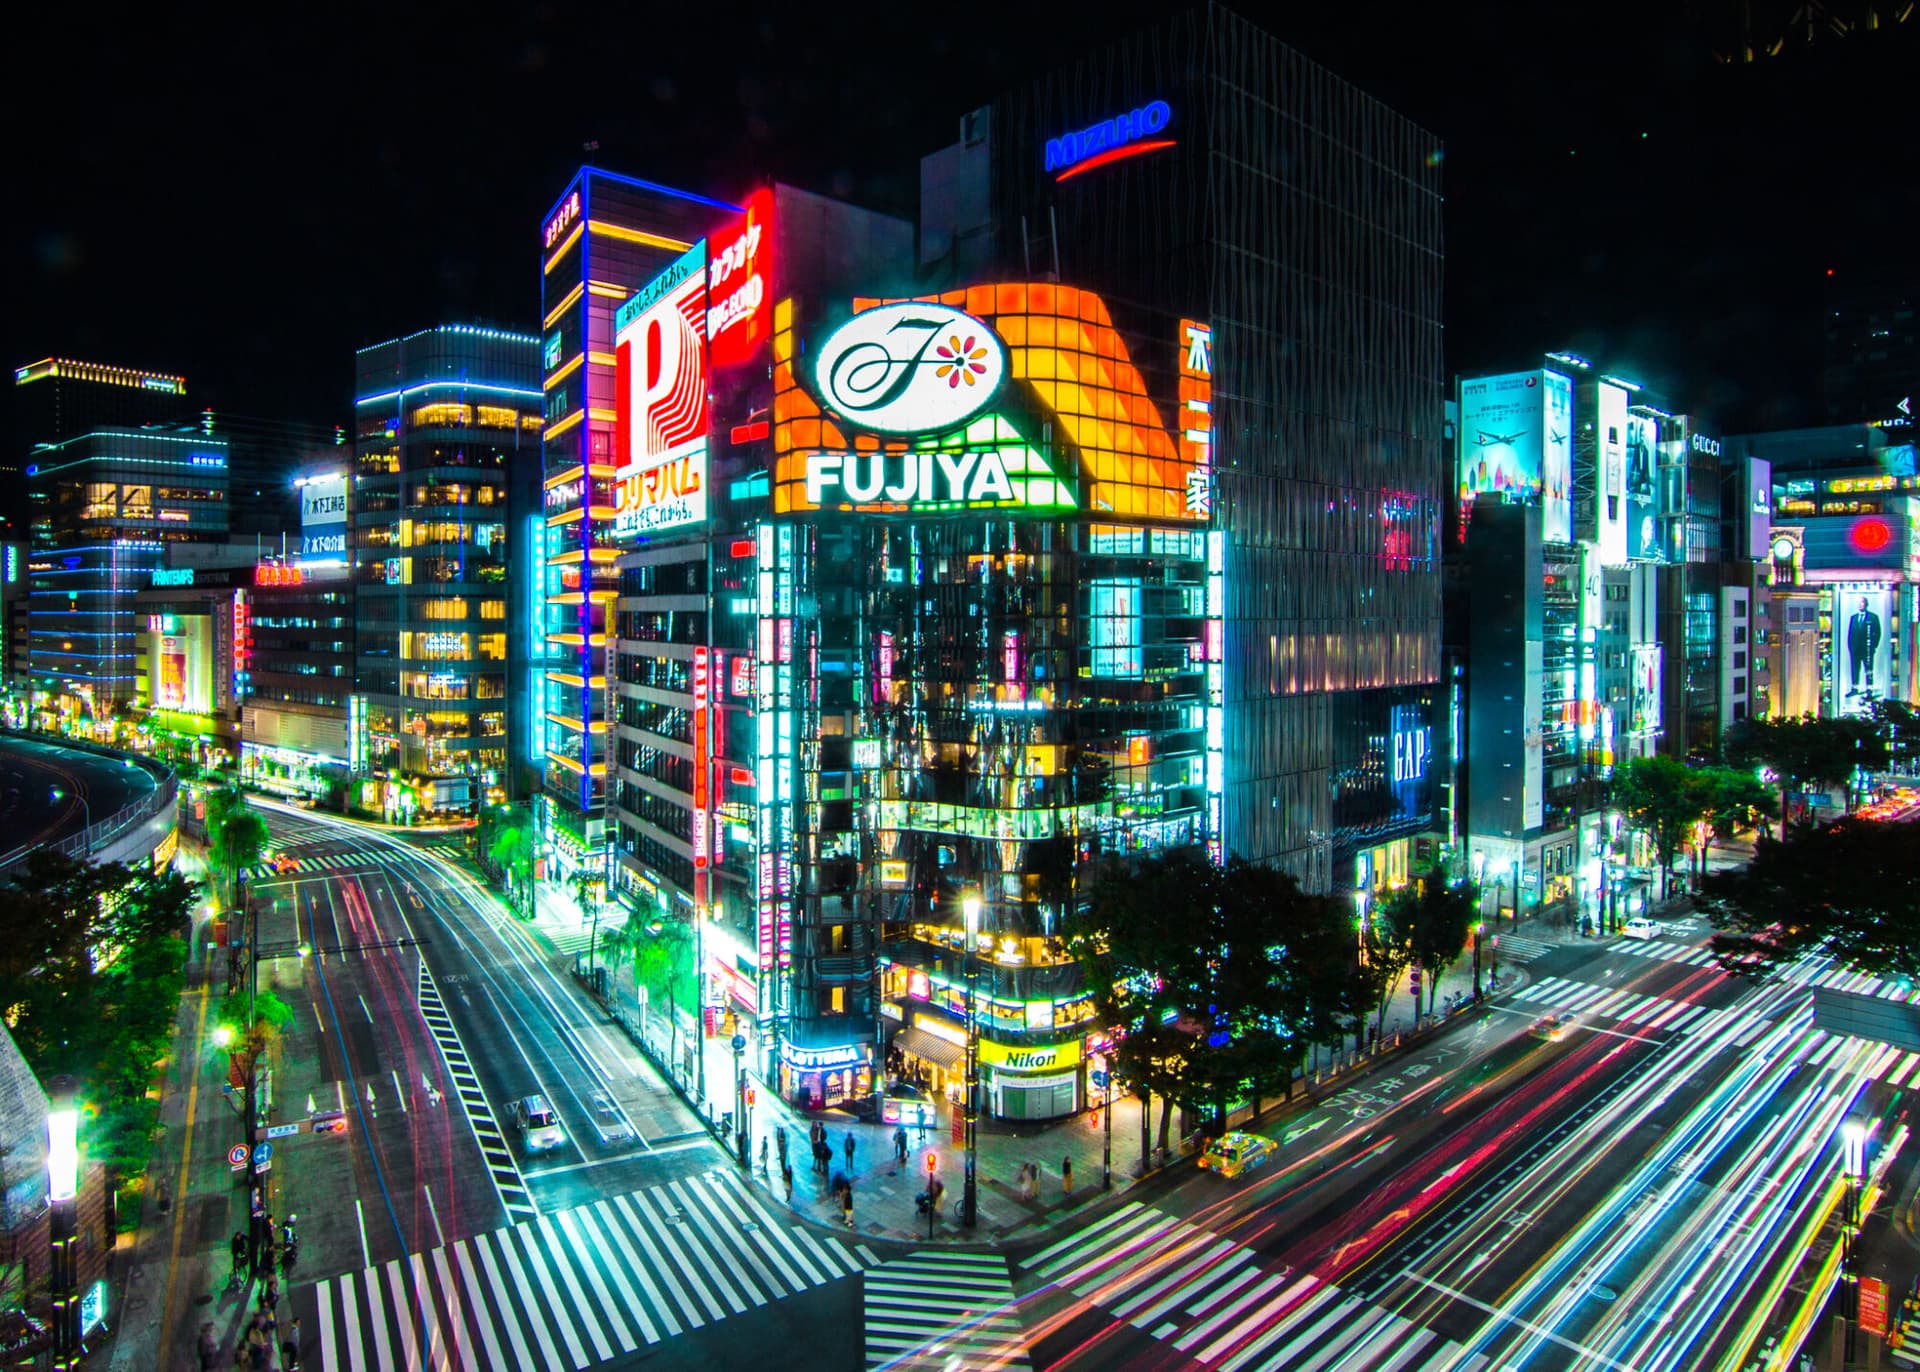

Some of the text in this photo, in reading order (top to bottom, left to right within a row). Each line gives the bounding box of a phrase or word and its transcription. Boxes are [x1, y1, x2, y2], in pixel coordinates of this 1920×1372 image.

[1045, 100, 1170, 171] MIZUHO
[709, 224, 762, 291] カラオケ
[729, 273, 764, 318] ECHO
[1186, 326, 1211, 516] 不二家
[1692, 433, 1720, 456] GUCCI
[614, 456, 701, 514] プリマハム
[807, 452, 1014, 501] FUJIYA
[152, 569, 194, 586] PRINTEMPS
[1394, 729, 1425, 781] GAP
[1006, 1051, 1057, 1068] Nikon
